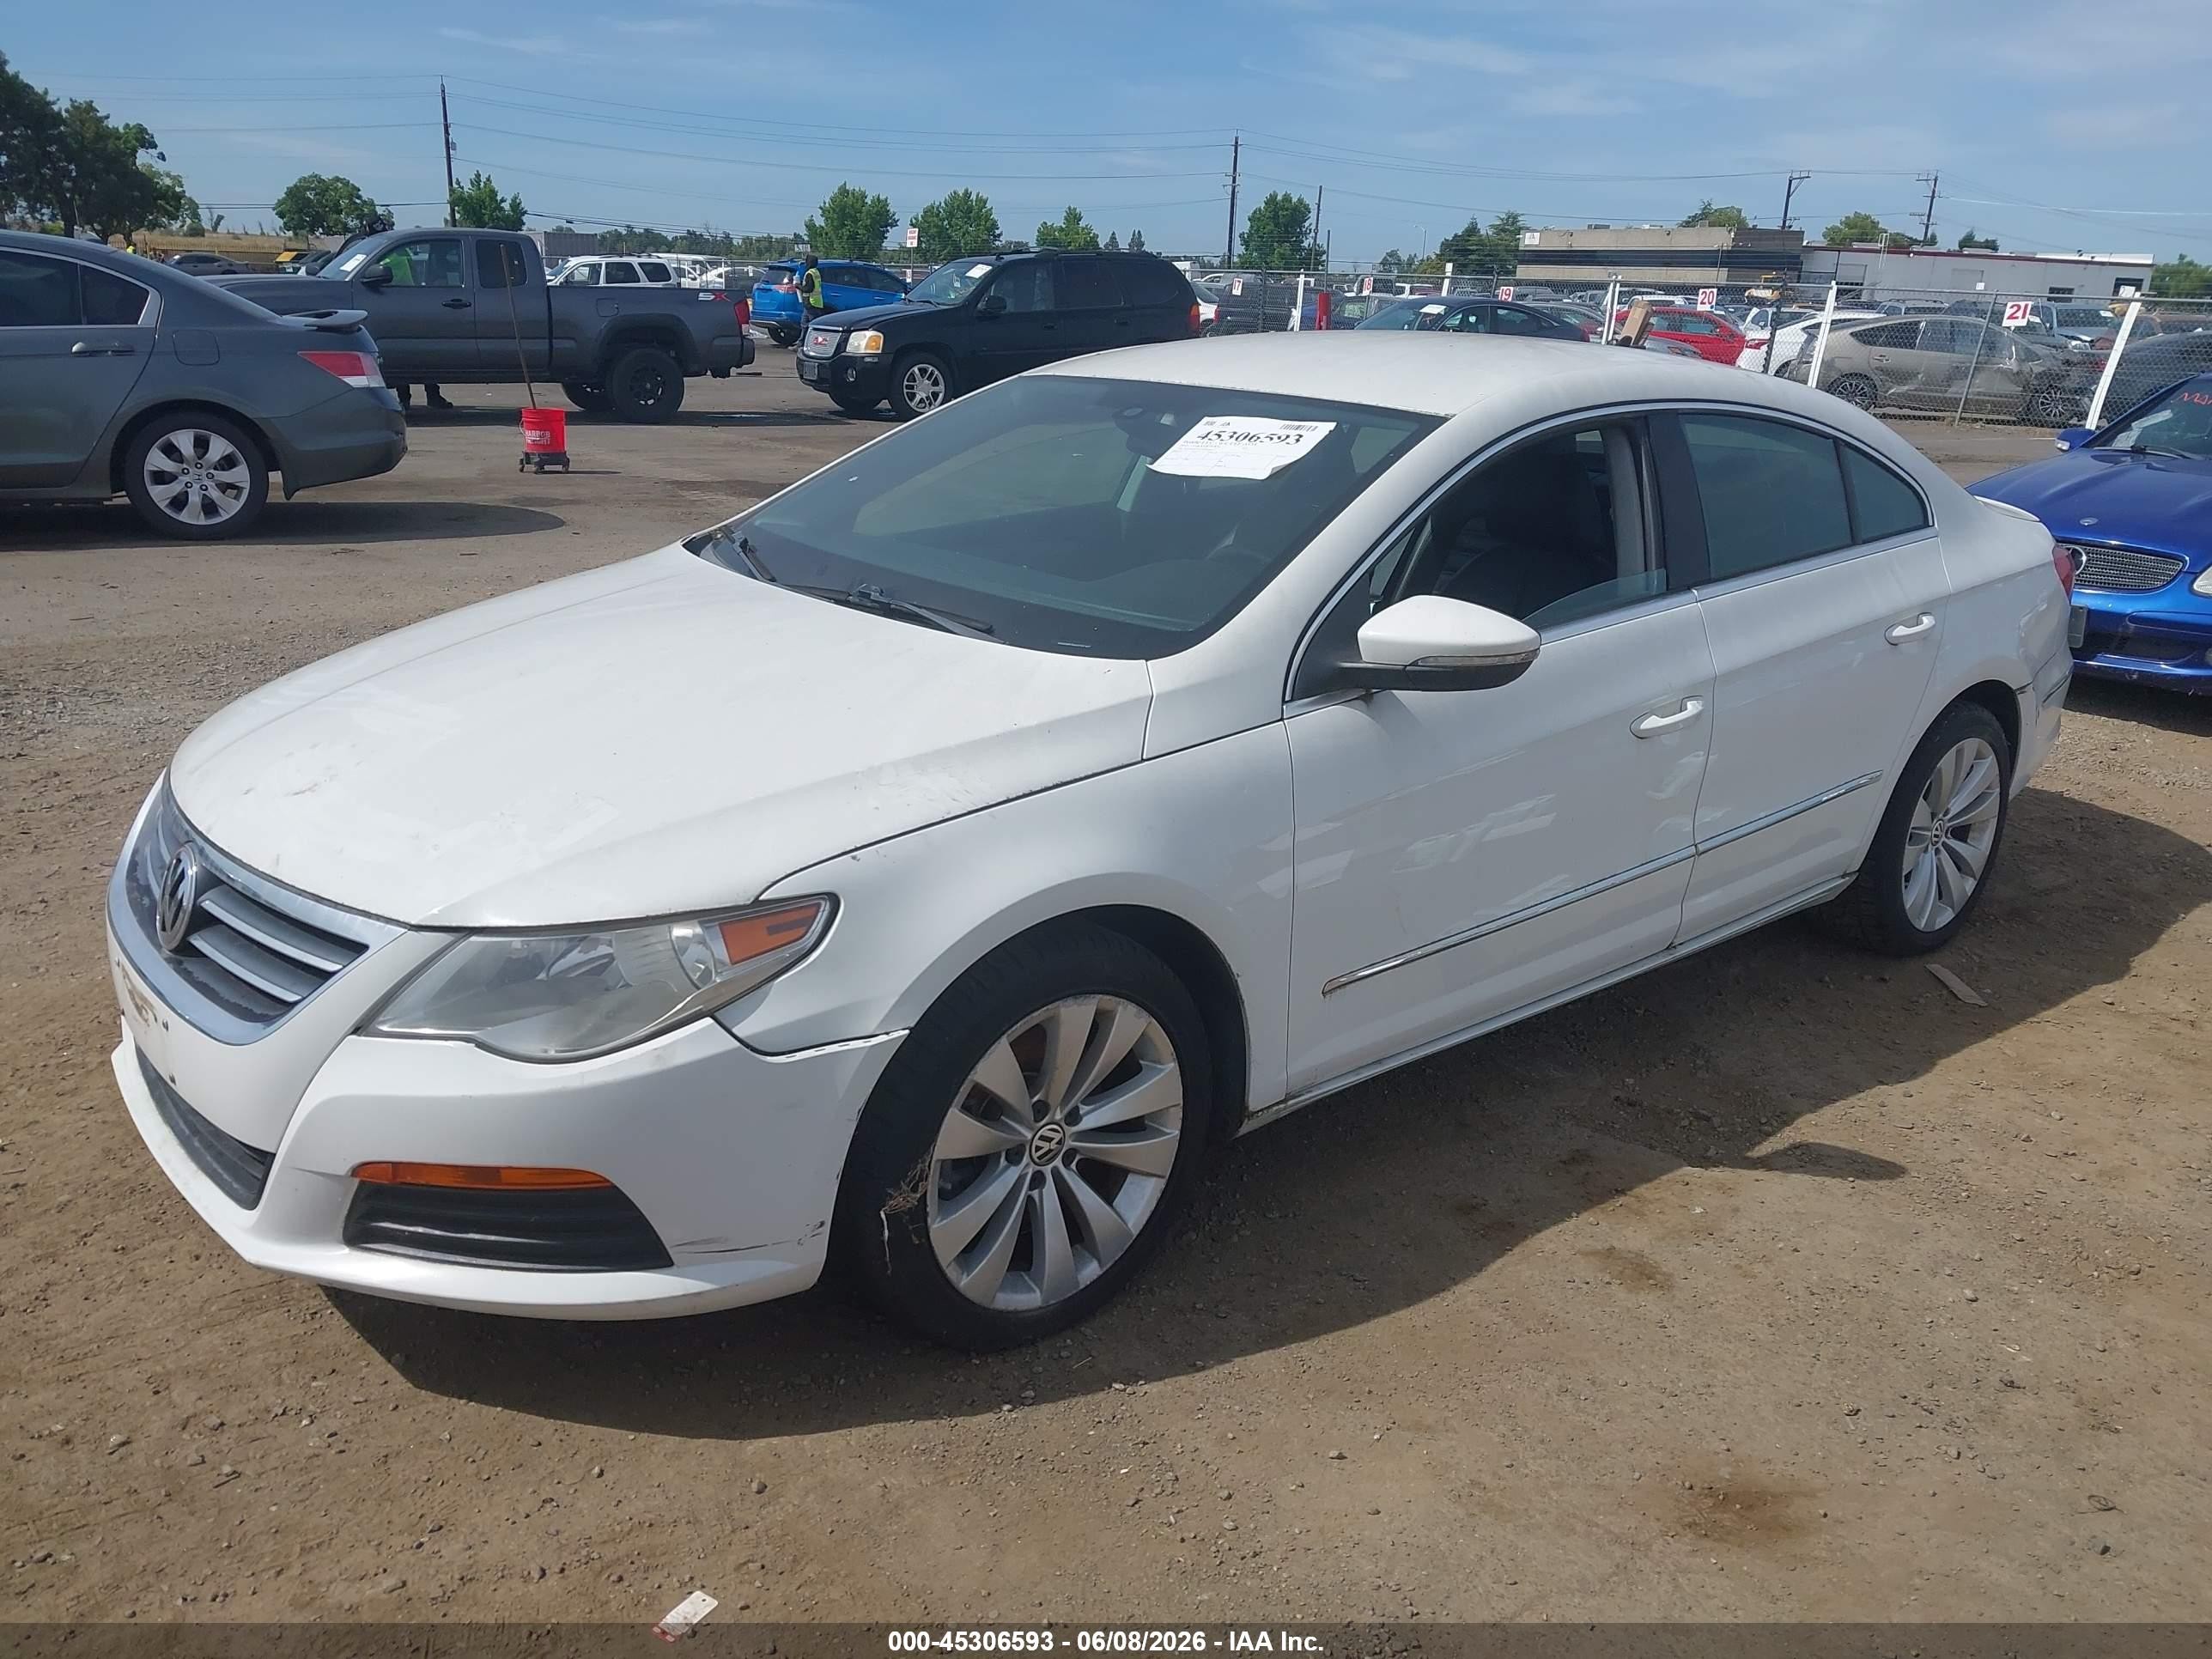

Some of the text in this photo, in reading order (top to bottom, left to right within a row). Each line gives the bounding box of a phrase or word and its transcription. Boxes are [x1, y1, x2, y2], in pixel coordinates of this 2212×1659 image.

[1233, 279, 1242, 291] 17
[1364, 278, 1372, 292] 18
[1499, 288, 1512, 301] 19
[1699, 290, 1715, 305] 20
[2006, 303, 2029, 320] 21
[1197, 429, 1304, 445] 45306593
